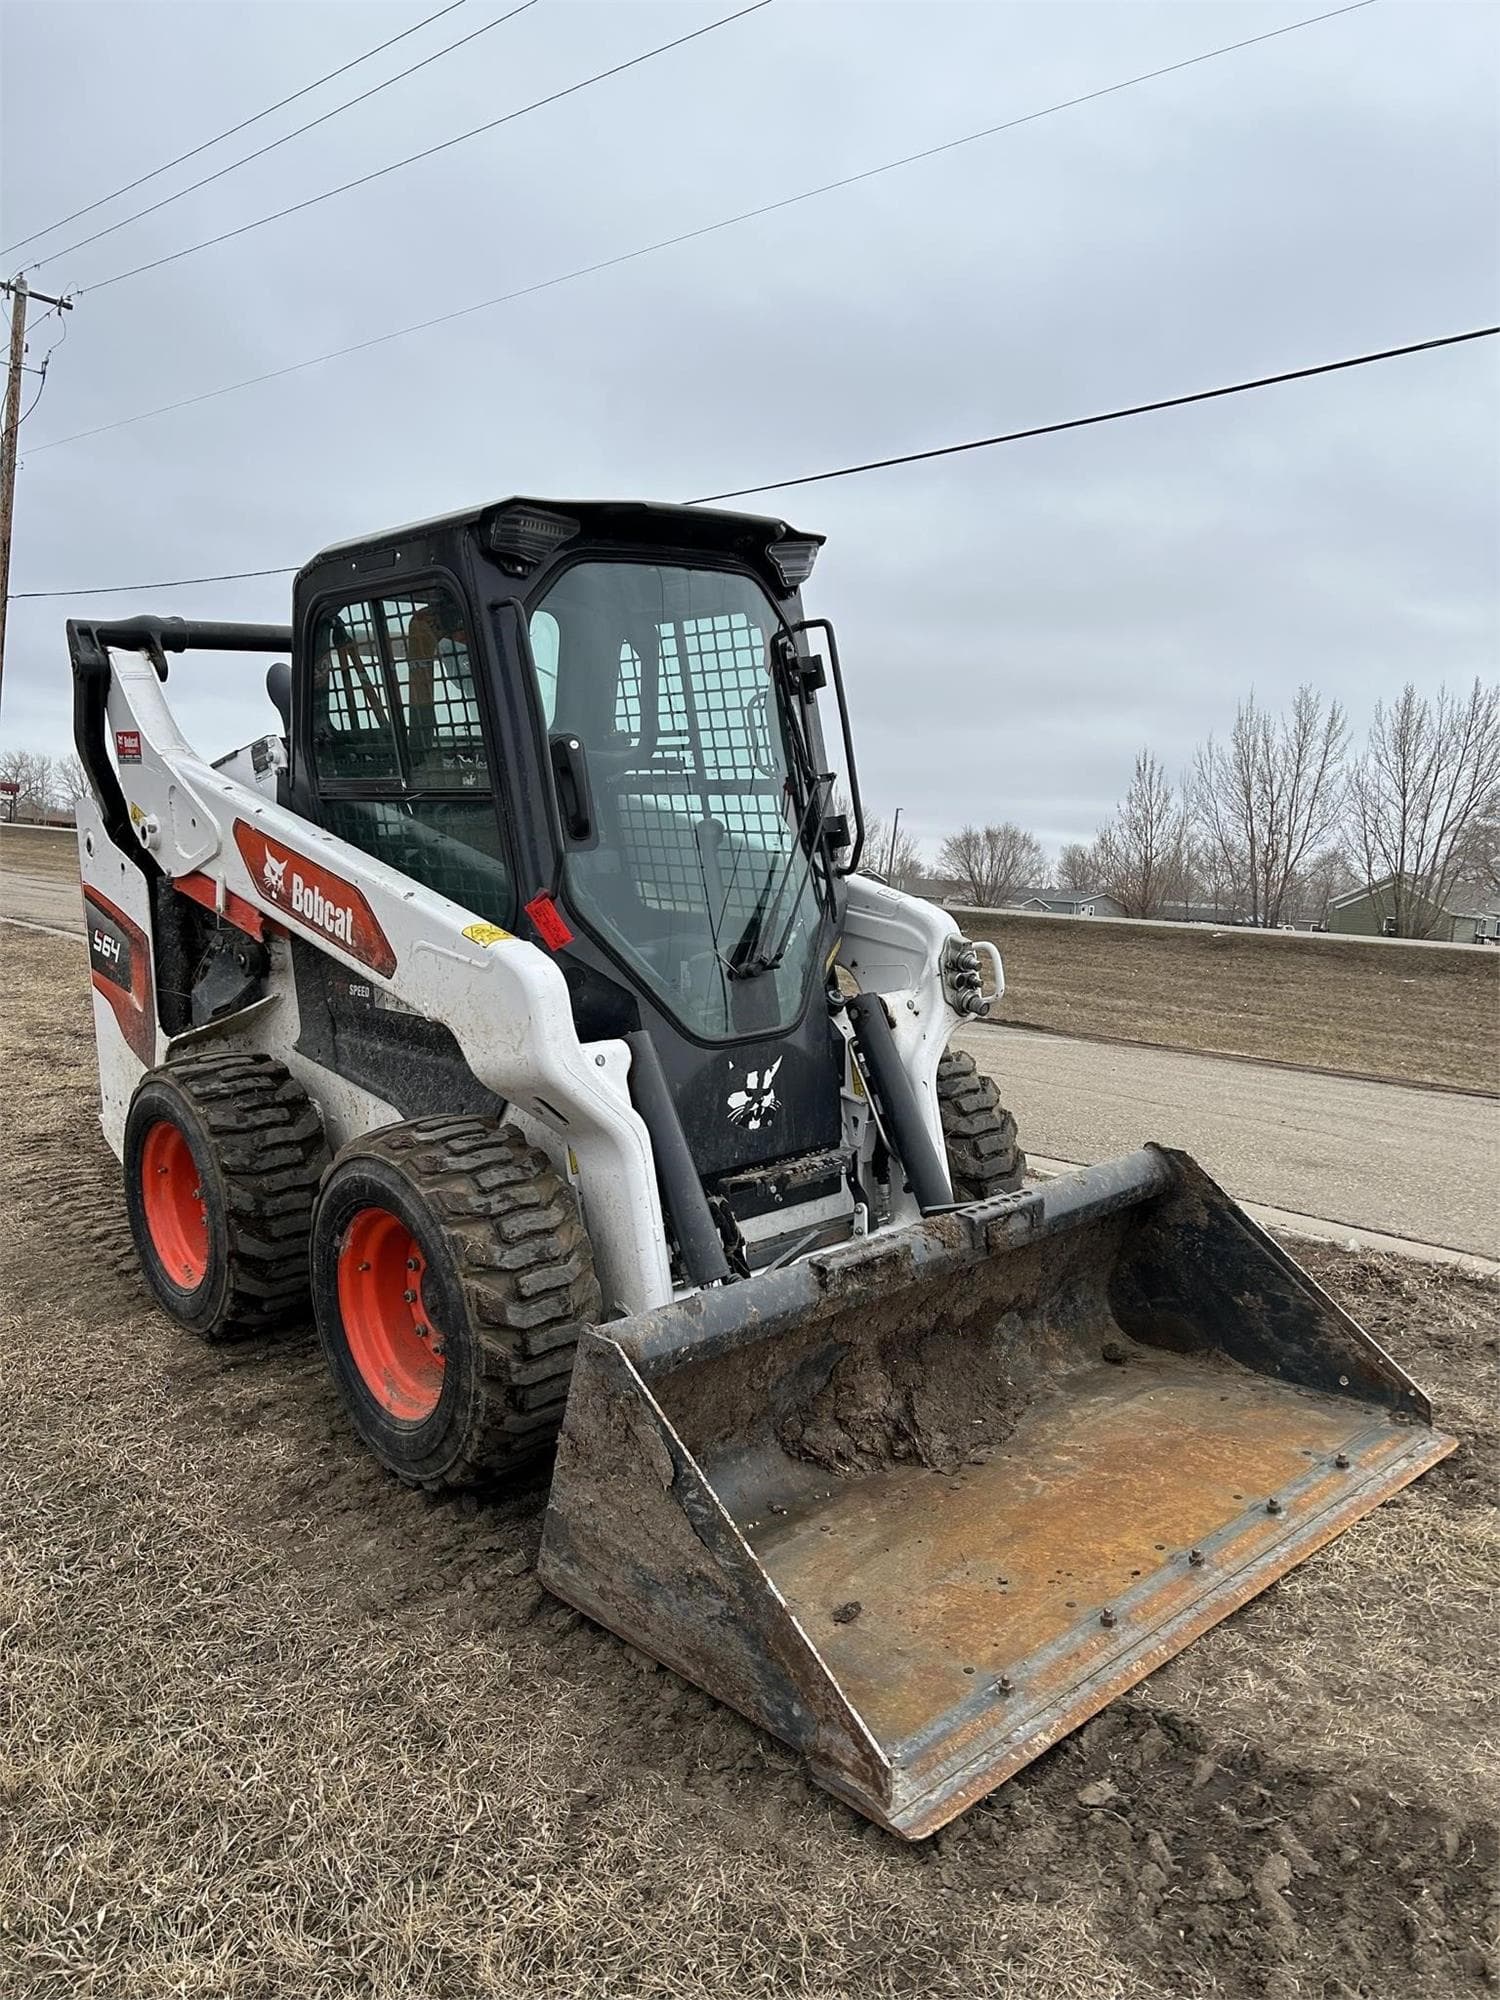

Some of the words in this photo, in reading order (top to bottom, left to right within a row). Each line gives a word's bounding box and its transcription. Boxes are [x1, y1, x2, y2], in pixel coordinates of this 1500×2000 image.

[292, 873, 353, 945] Bobcat
[94, 930, 120, 962] S64
[349, 984, 370, 998] SPEED
